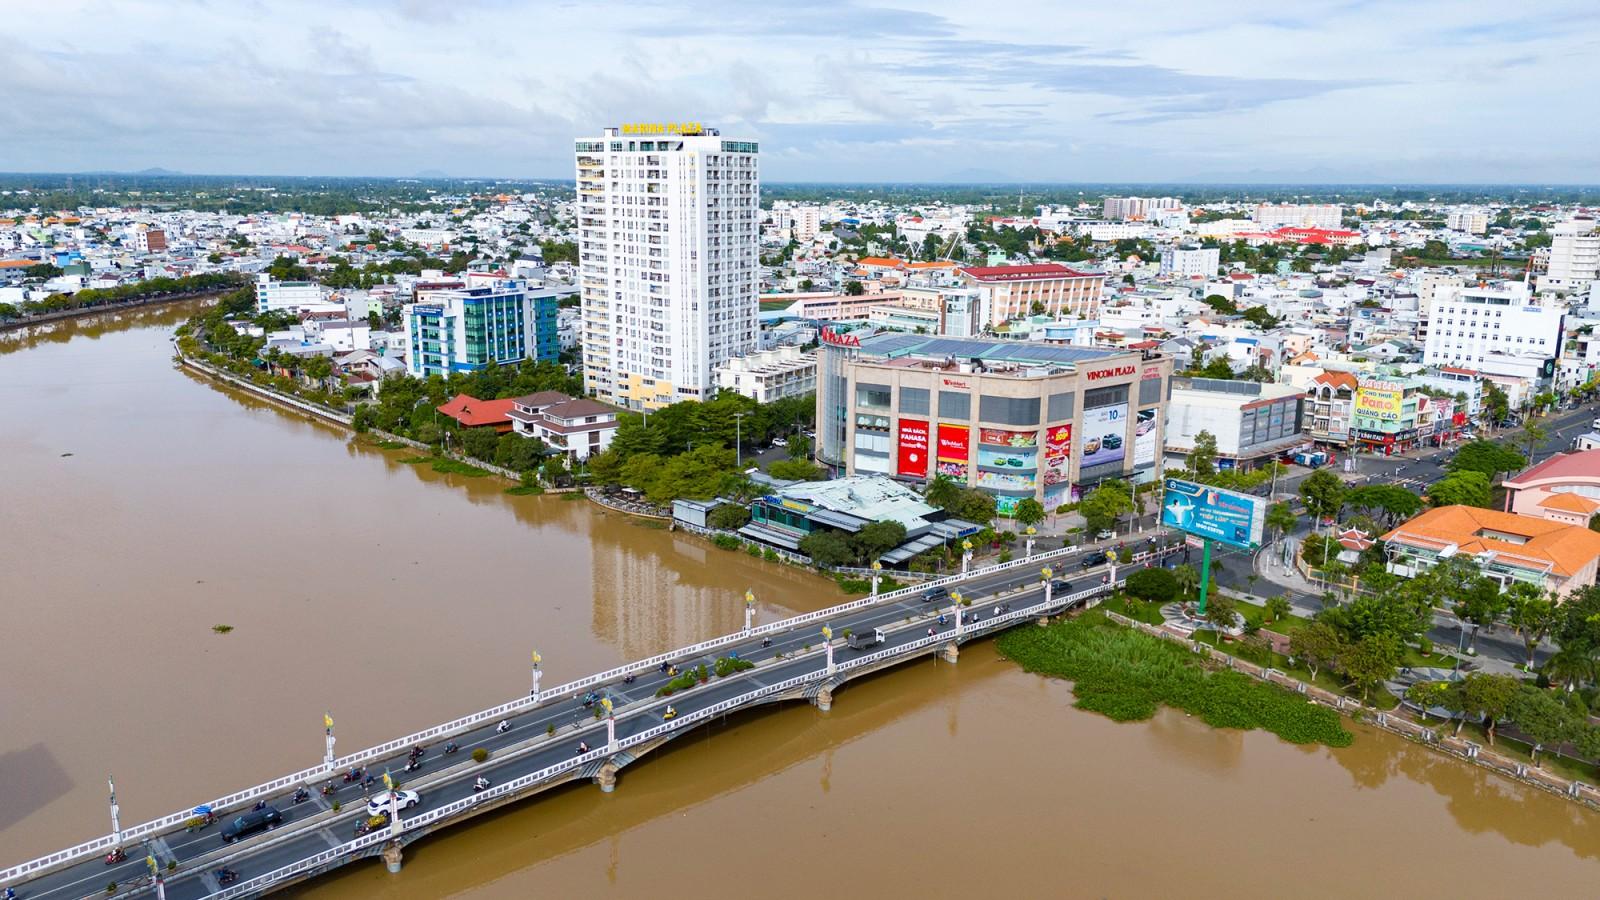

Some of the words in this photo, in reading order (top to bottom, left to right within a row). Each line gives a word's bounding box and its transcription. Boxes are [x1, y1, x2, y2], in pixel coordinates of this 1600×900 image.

[623, 123, 664, 134] MARINA
[667, 122, 702, 134] PLAZA
[1087, 369, 1113, 380] VINCOM
[1115, 365, 1136, 377] PLAZA
[1362, 396, 1393, 410] Pano
[1109, 409, 1118, 420] 10
[901, 434, 926, 442] FAHASA
